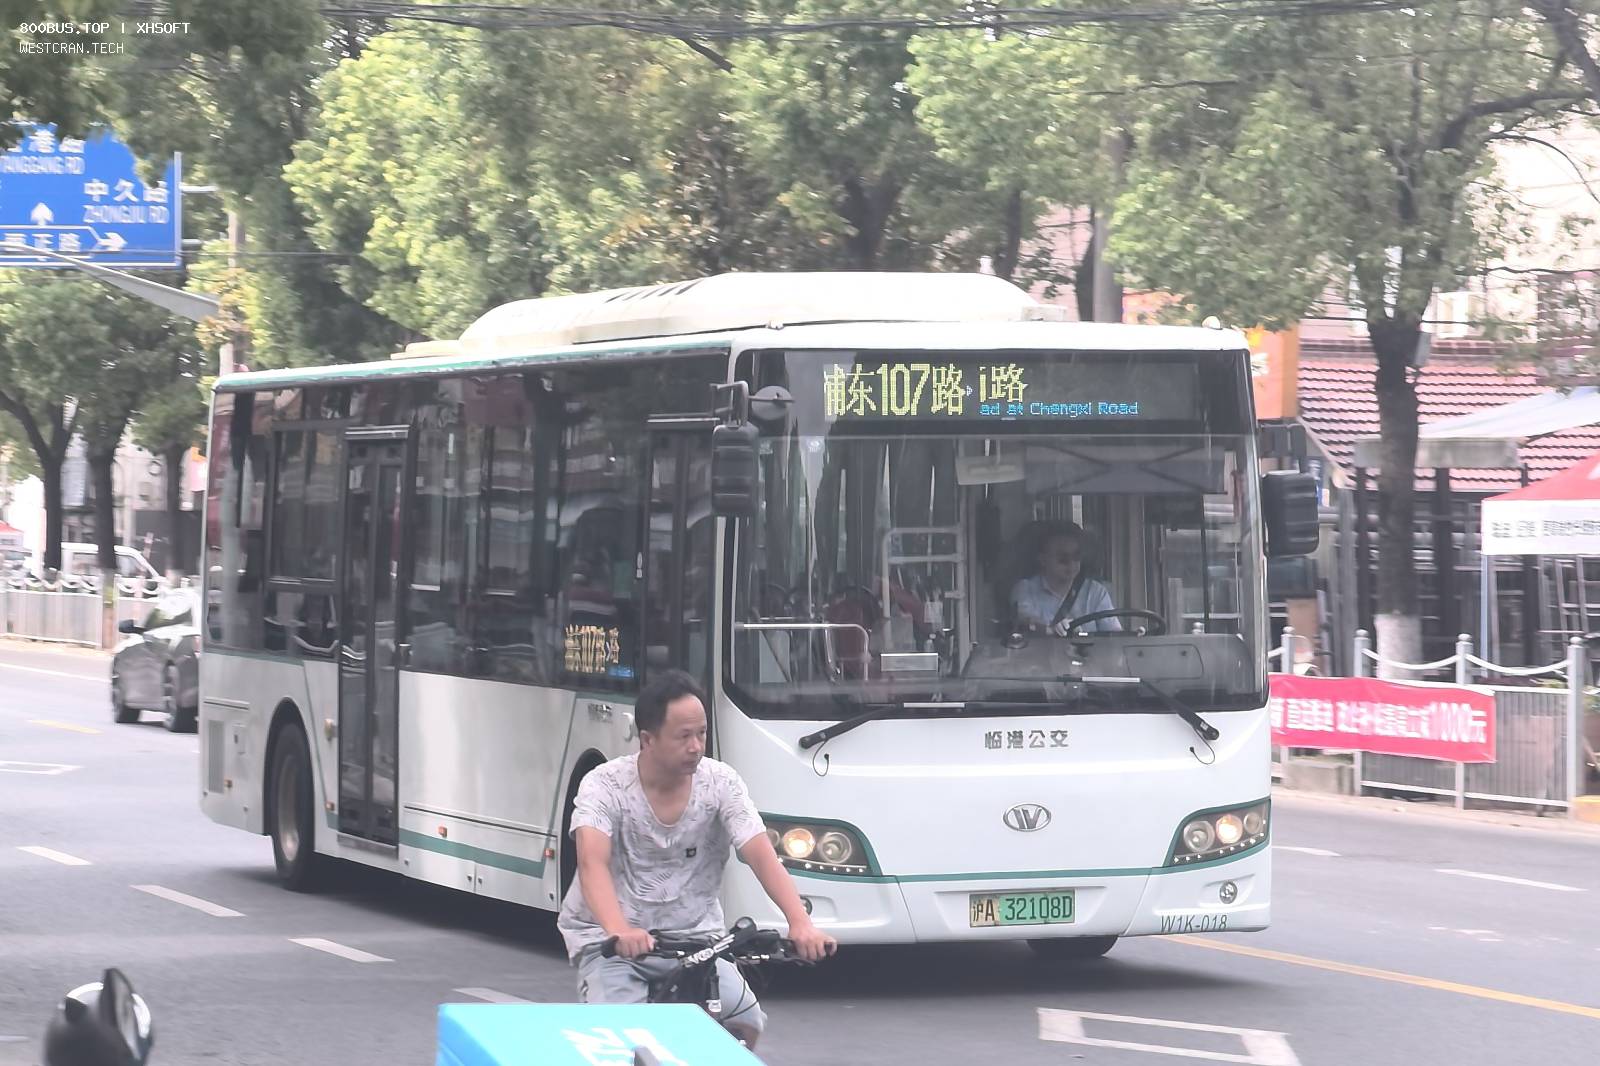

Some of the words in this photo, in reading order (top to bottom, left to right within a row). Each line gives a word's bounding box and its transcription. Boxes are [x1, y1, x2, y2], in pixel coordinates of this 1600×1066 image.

[1098, 402, 1138, 415] Road
[984, 729, 1070, 750] 临港公交
[1004, 895, 1073, 921] 32108D
[1160, 914, 1229, 934] W1K-018
